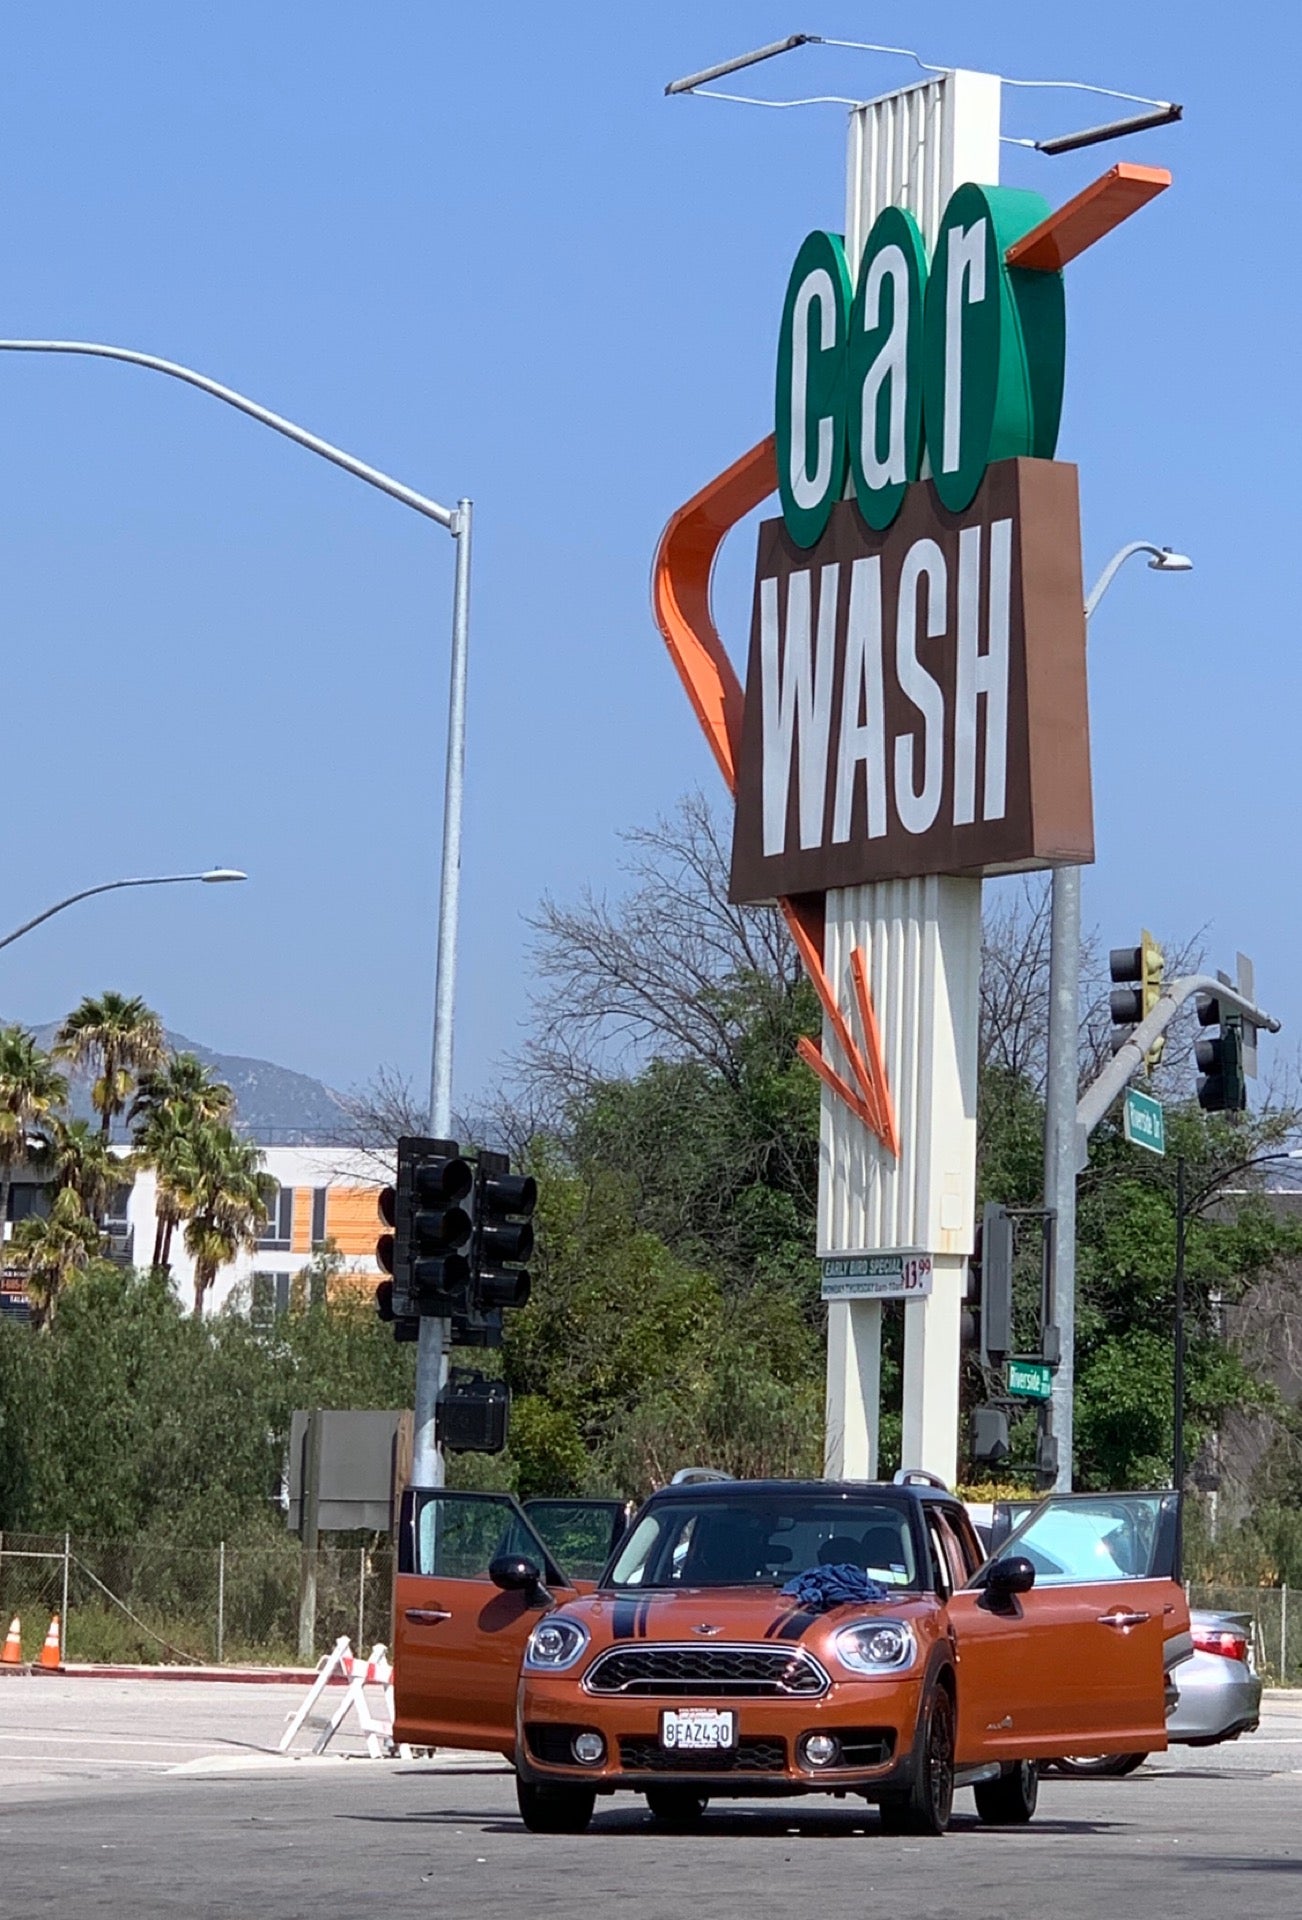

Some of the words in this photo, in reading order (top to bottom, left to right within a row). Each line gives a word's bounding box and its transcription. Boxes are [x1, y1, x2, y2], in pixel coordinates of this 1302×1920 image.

[791, 217, 987, 510] car
[760, 518, 1013, 857] WASH
[1129, 1101, 1153, 1136] Riverside
[825, 1261, 847, 1277] EARLY
[849, 1260, 868, 1276] BIRD
[870, 1257, 902, 1275] SPECIAL
[1010, 1365, 1040, 1392] Riverside
[666, 1723, 729, 1742] 8EAZ430
